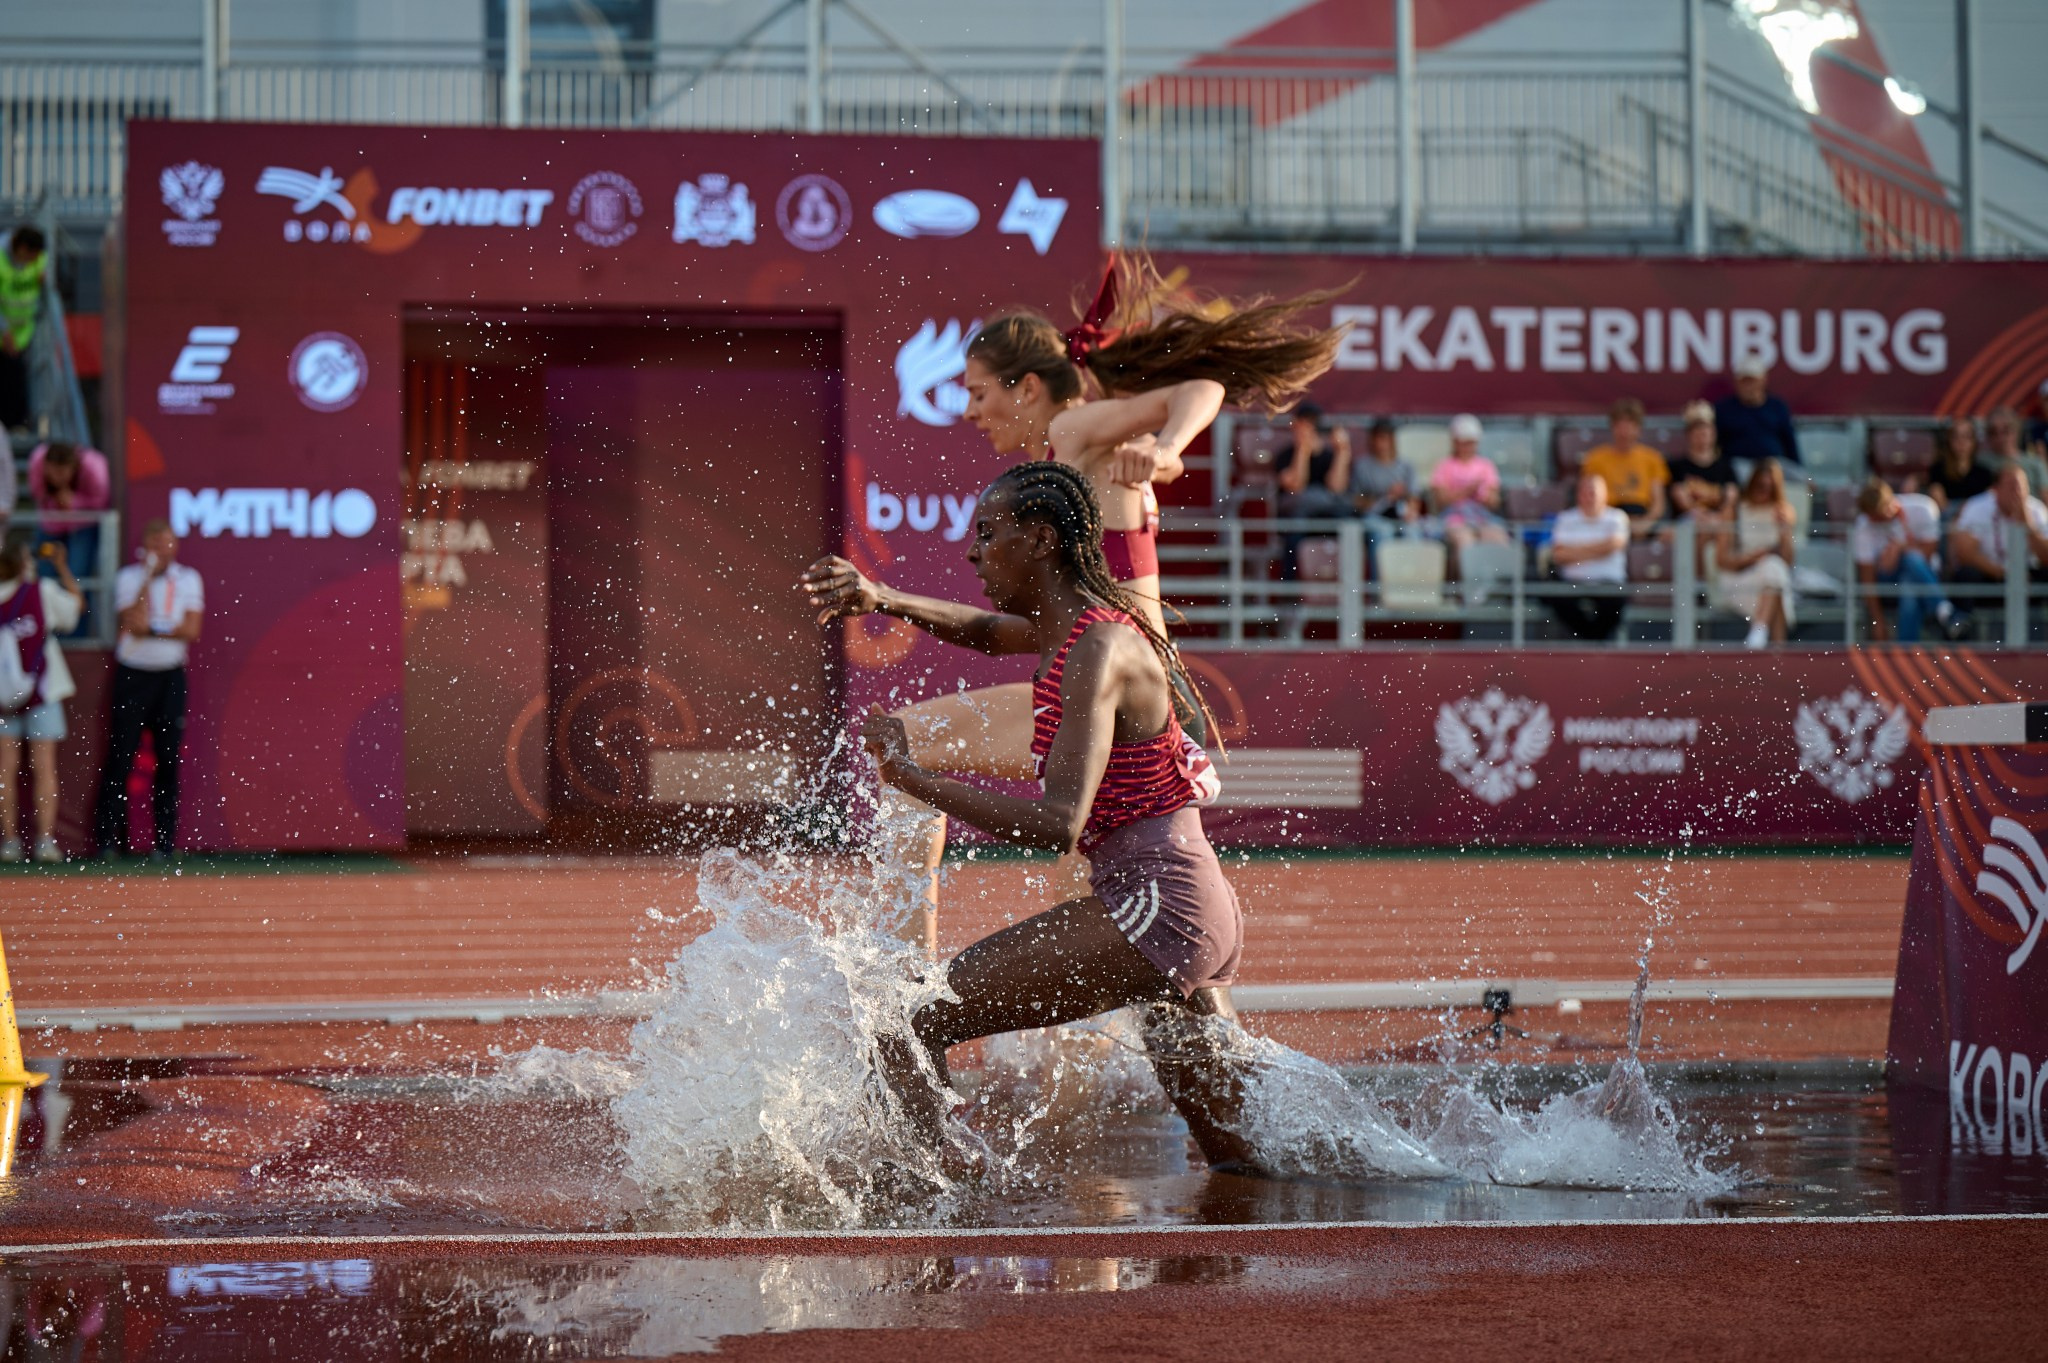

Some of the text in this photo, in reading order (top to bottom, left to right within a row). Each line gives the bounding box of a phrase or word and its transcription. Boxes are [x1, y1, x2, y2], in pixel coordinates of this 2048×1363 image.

[387, 187, 554, 227] FONBET
[1331, 304, 1947, 375] EKATERINBURG
[866, 481, 977, 542] buy
